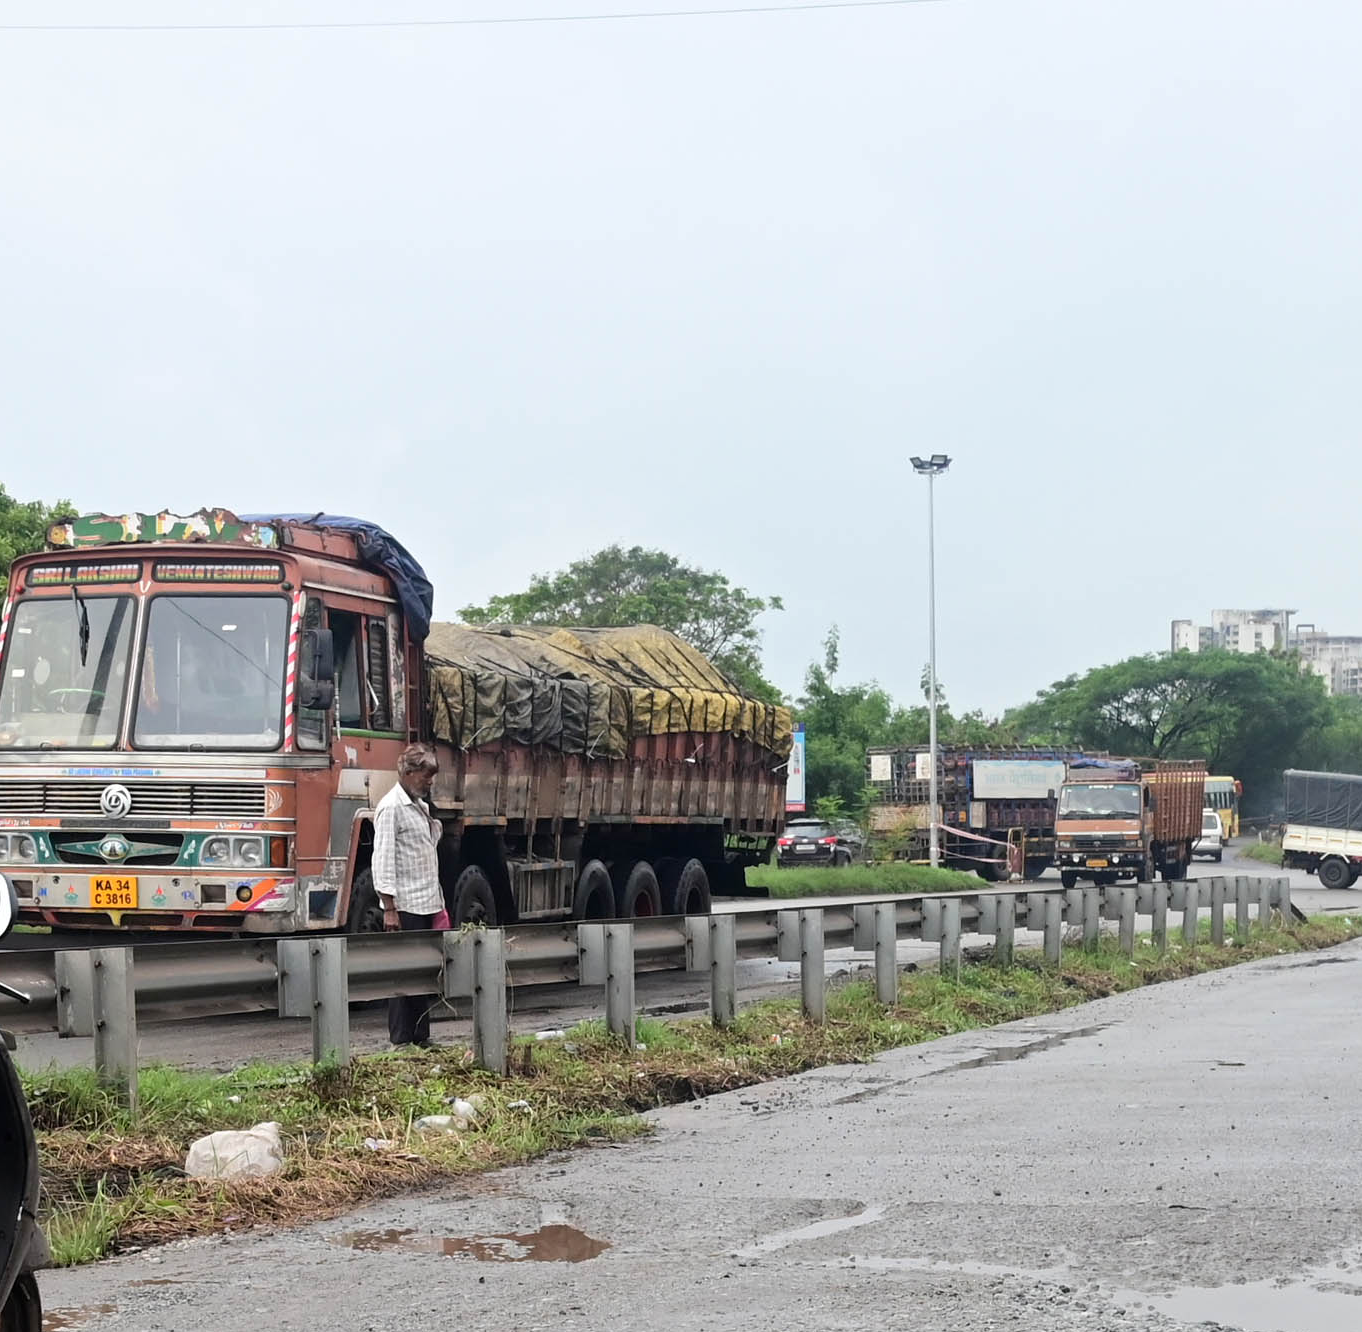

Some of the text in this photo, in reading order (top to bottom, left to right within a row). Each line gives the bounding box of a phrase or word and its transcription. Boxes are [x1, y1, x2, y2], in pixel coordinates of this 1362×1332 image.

[95, 880, 130, 890] KA 34
[94, 893, 132, 904] C 3816
